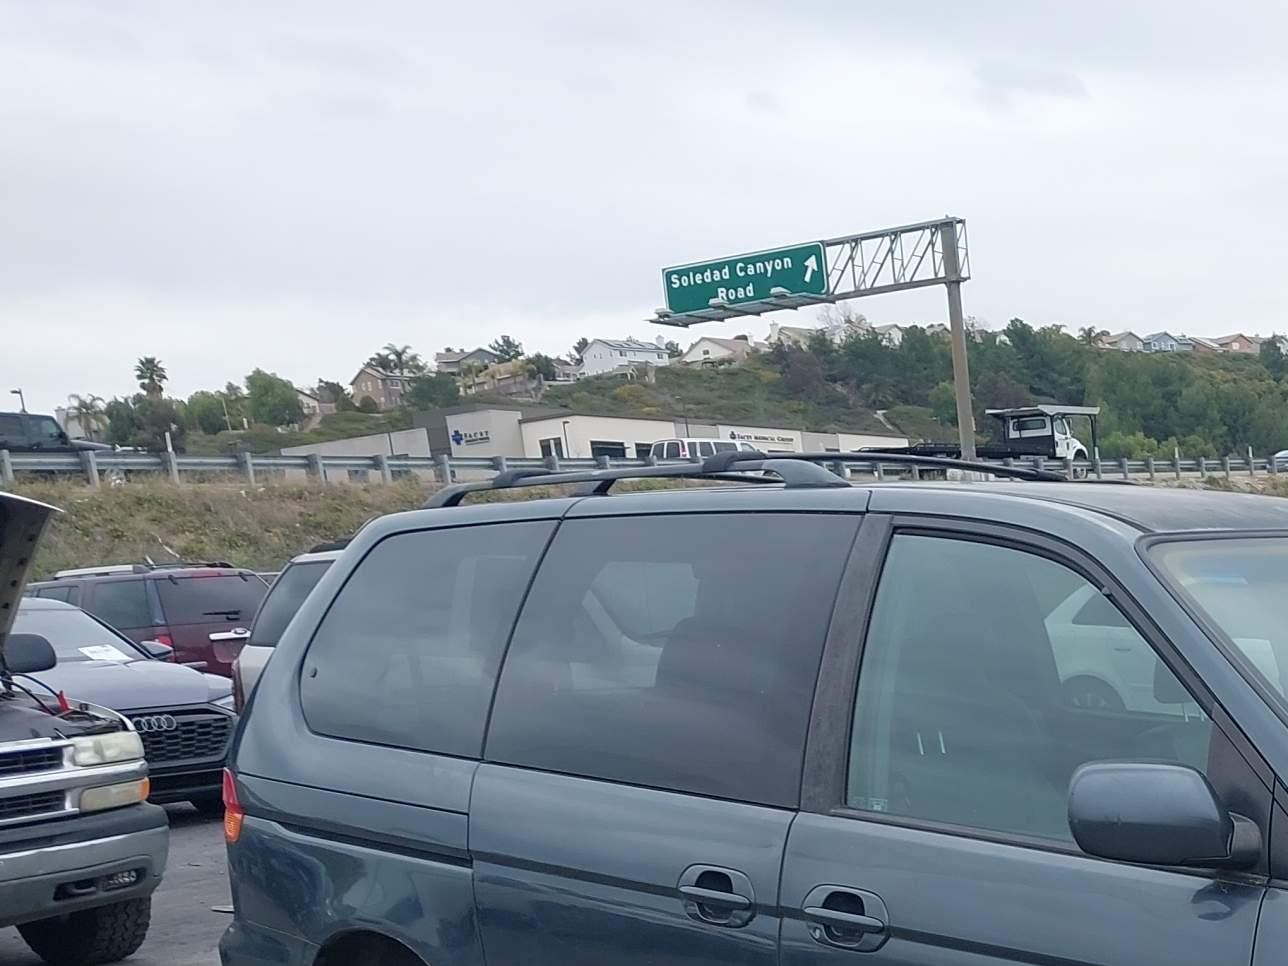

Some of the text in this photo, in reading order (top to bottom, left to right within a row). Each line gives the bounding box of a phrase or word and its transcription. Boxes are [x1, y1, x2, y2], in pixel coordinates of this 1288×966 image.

[671, 257, 792, 288] Soledad Canyon
[717, 283, 754, 301] Road
